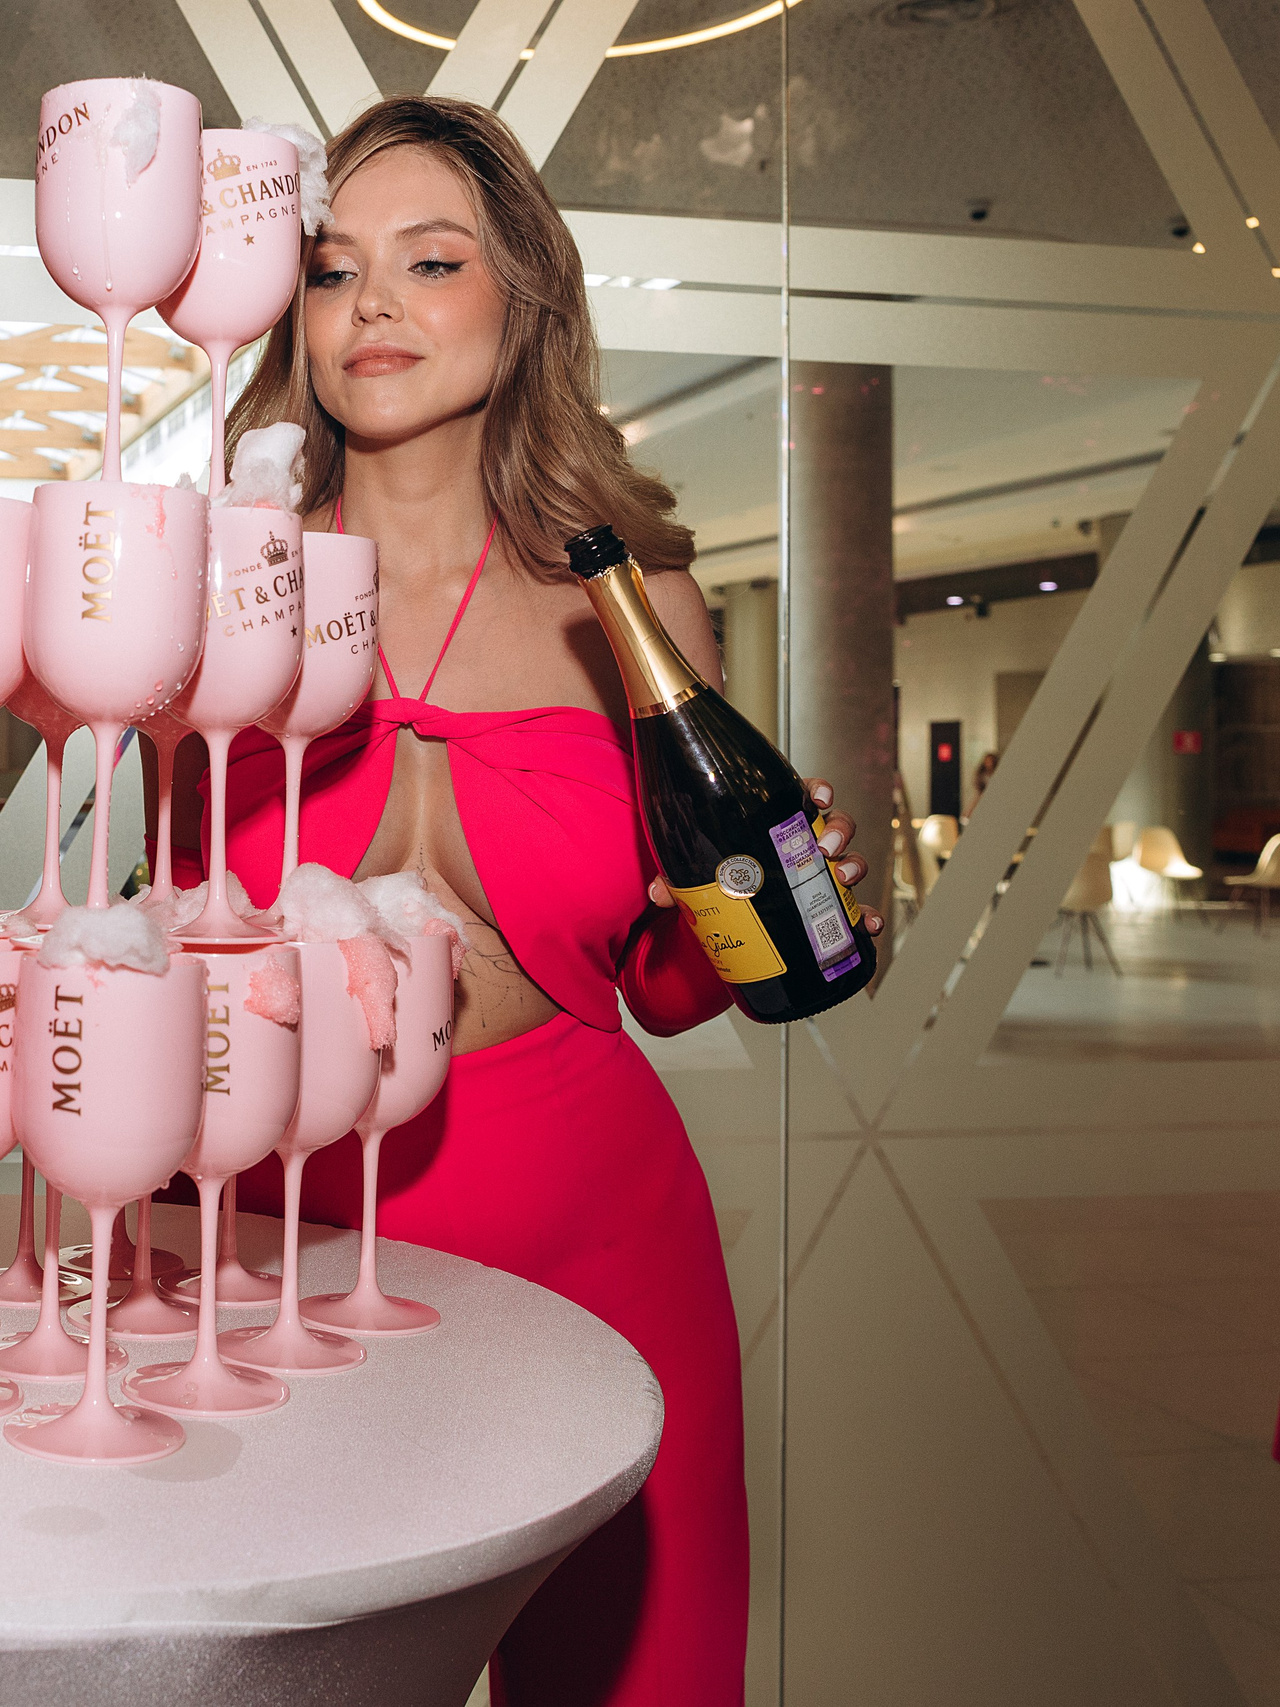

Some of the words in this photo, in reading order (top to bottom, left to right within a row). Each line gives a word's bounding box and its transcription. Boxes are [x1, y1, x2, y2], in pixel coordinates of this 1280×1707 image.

[246, 164, 258, 172] EN
[260, 160, 278, 169] 1743
[78, 500, 116, 624] MOËT
[254, 585, 271, 605] &
[304, 611, 367, 649] MOËT
[369, 609, 377, 627] &
[776, 819, 804, 838] РОССИЙСКАЯ
[778, 823, 806, 842] ФЕДЕРАЦИЯ
[796, 857, 813, 868] МАРКА
[693, 906, 720, 918] NOTTI
[705, 934, 746, 957] Gialla
[48, 984, 84, 1117] MOËT
